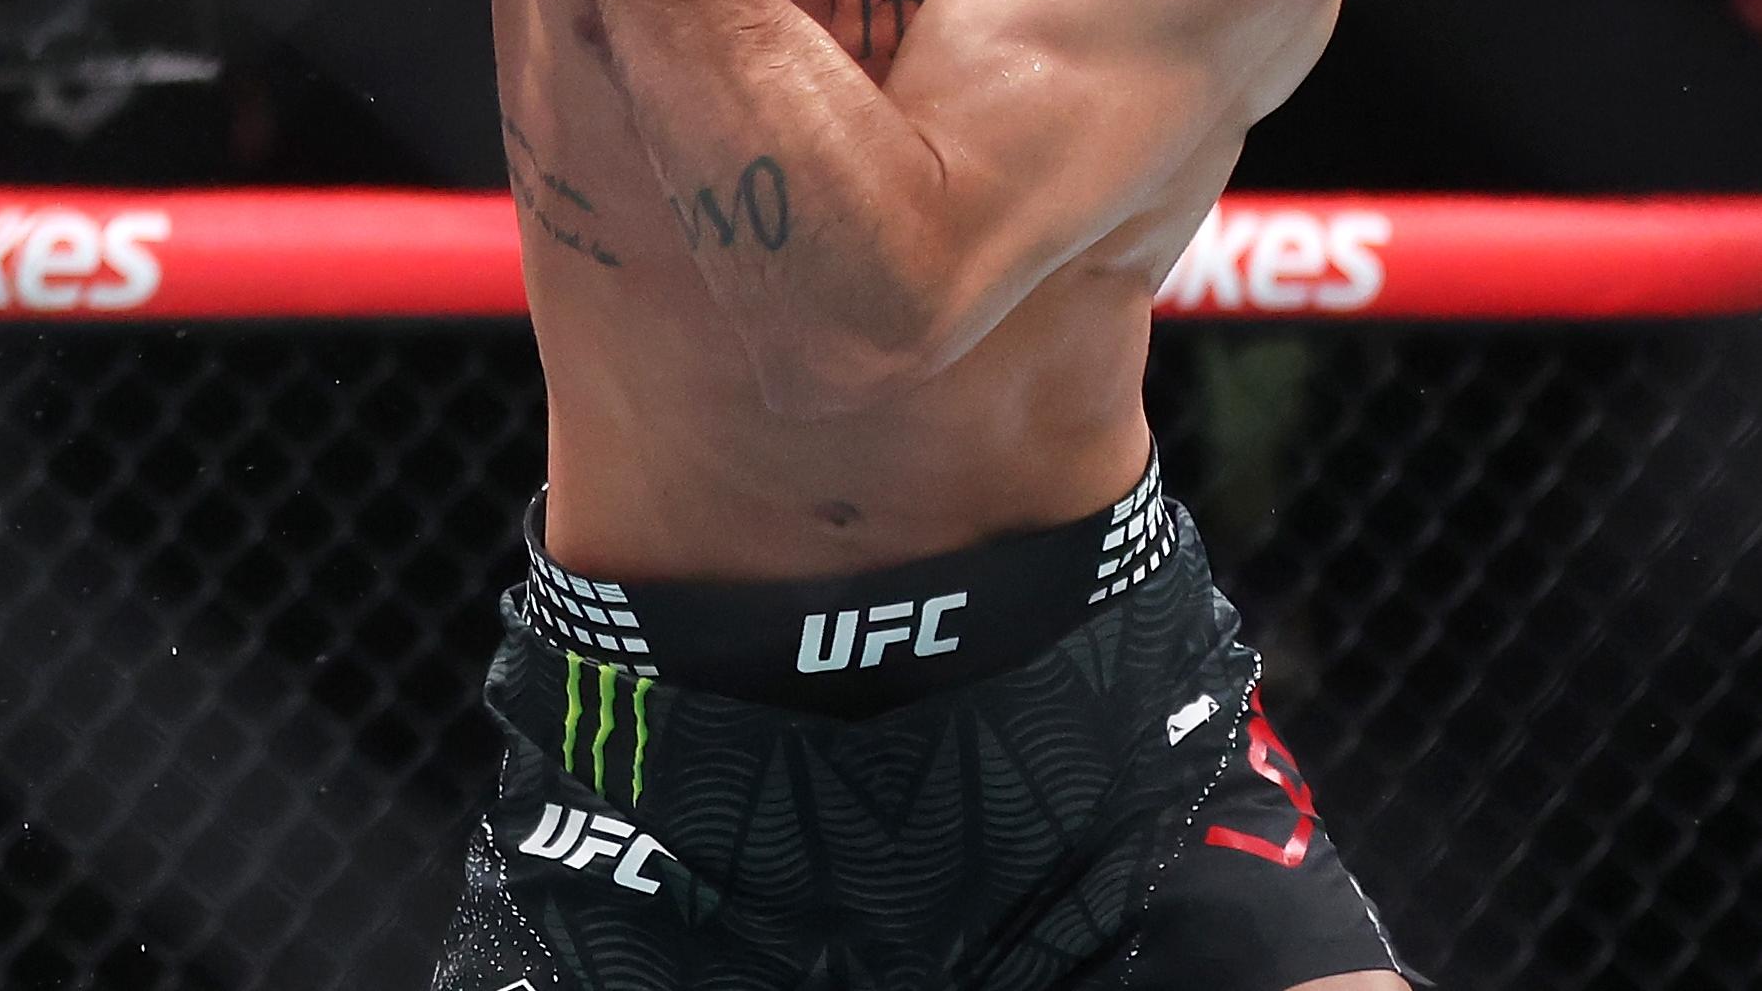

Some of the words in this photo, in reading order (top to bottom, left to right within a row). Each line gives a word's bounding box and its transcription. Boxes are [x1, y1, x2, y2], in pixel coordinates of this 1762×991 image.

[1152, 201, 1392, 311] kes
[795, 590, 969, 675] UFC
[517, 802, 679, 896] UFC
